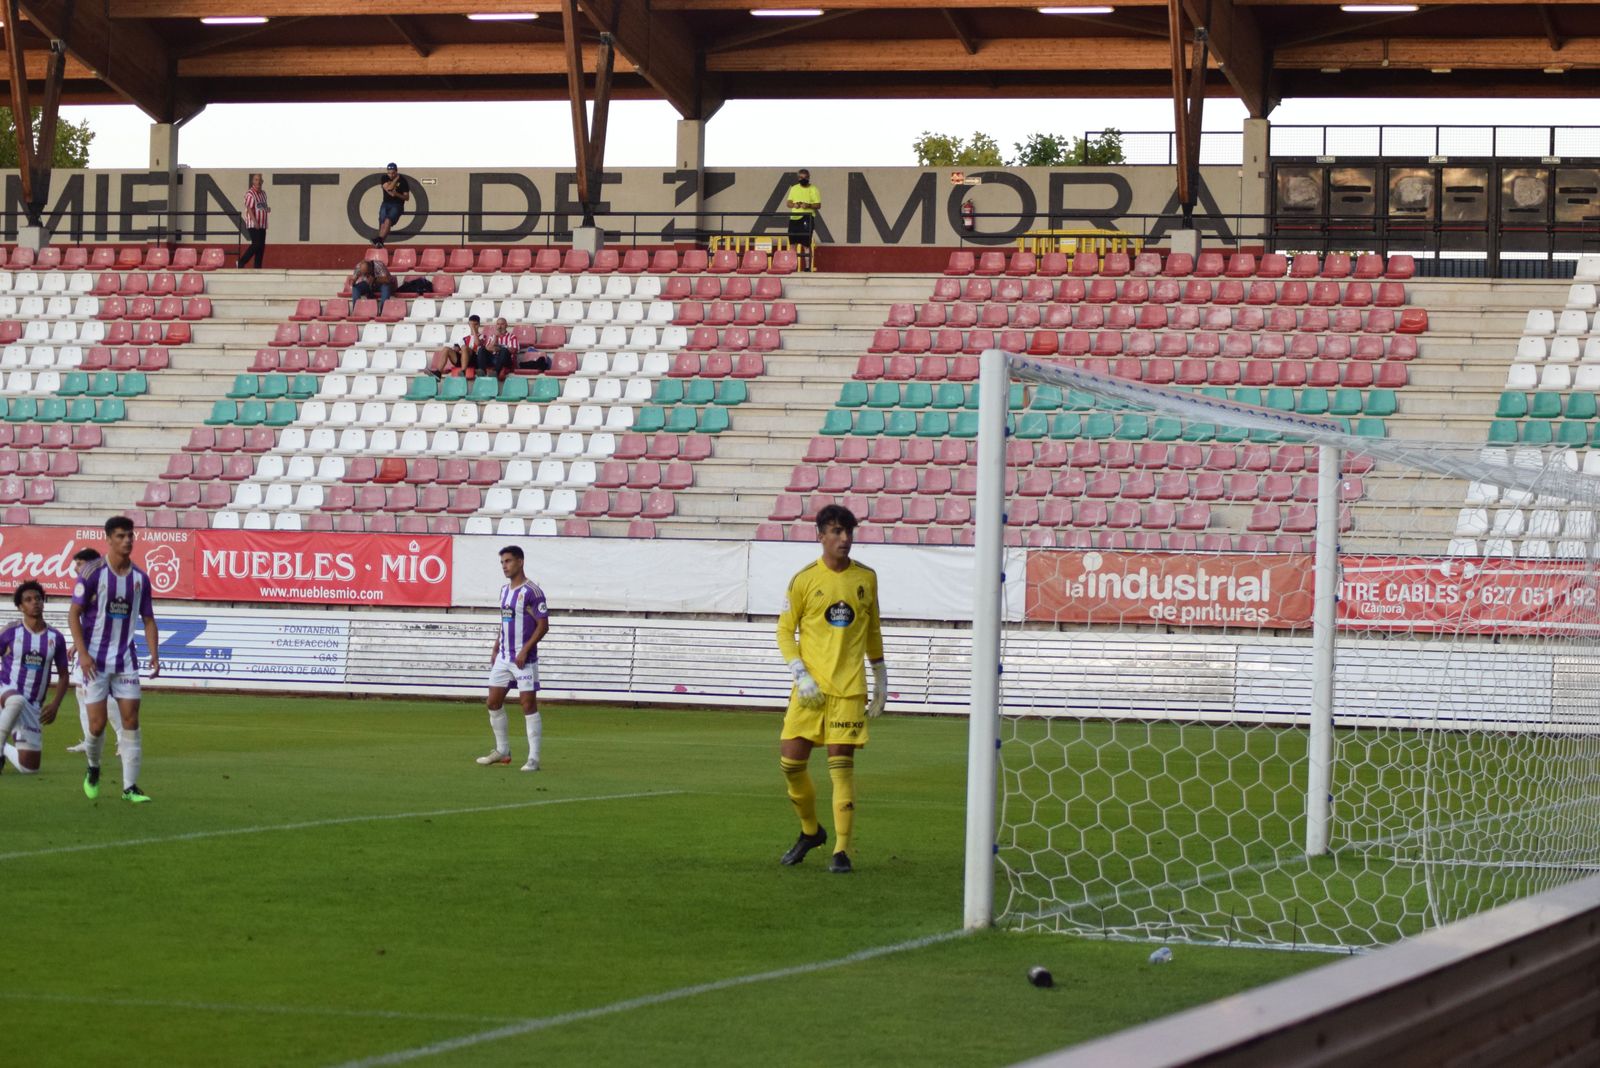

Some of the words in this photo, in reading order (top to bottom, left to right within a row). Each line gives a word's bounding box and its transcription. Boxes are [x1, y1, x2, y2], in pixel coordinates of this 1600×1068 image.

[469, 173, 622, 243] DE
[141, 532, 188, 542] JAMONES
[202, 550, 356, 581] MUEBLES
[1065, 579, 1084, 598] la
[1087, 566, 1271, 602] industrial
[259, 585, 384, 600] www.mueblesmio.com
[1385, 584, 1459, 604] CABLES
[1481, 586, 1517, 606] 627
[1149, 602, 1177, 620] de
[1181, 603, 1270, 624] pinturas
[284, 624, 340, 634] FONTANERÍA
[276, 639, 339, 648] CALEFACCIÓN
[204, 648, 230, 659] S.L.
[319, 653, 338, 662] GAS
[251, 664, 294, 673] CUARTOS
[296, 666, 309, 674] DE
